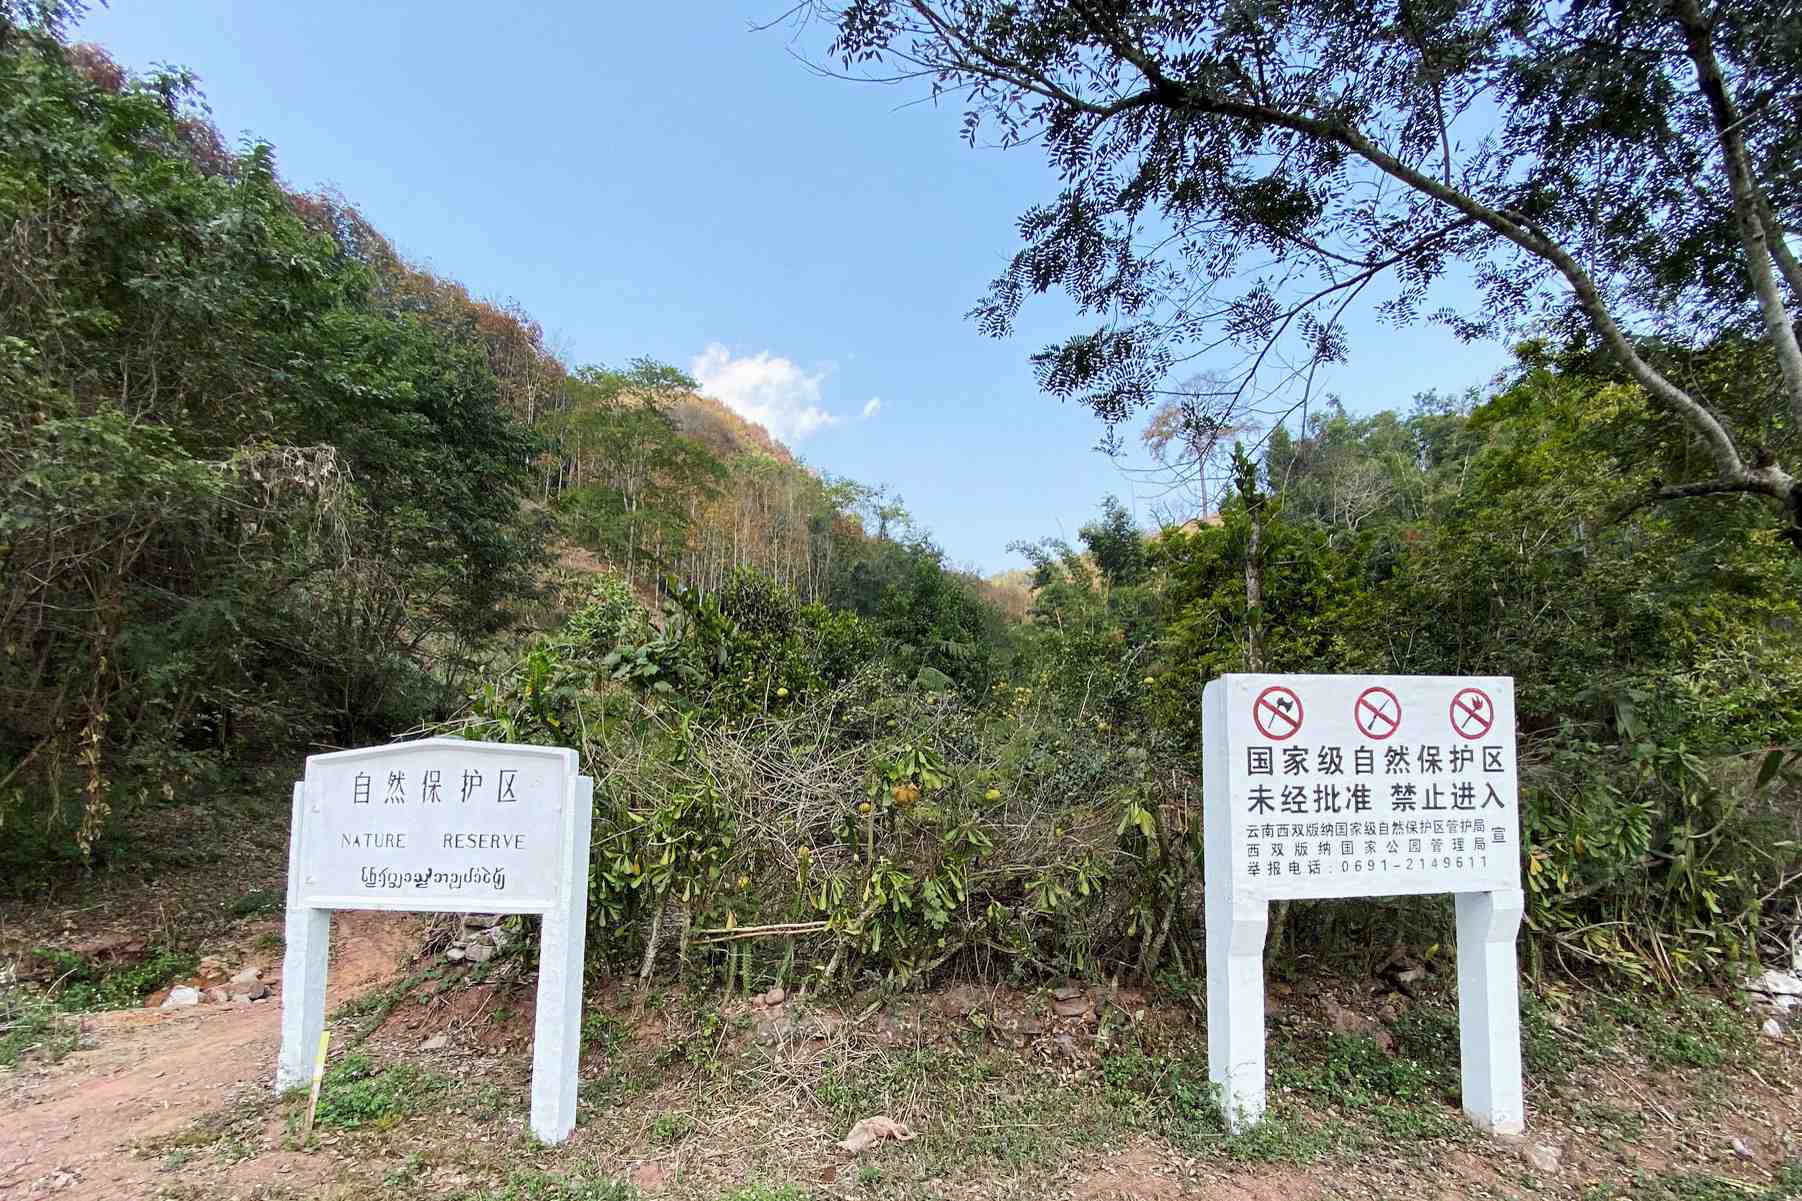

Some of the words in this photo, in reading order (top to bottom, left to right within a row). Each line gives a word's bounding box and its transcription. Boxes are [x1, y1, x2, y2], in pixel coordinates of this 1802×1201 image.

[1247, 745, 1505, 776] 国家级自然保护区
[354, 769, 518, 804] 自然保护区
[1247, 785, 1373, 815] 未经批准
[1391, 783, 1506, 813] 禁止进入
[341, 832, 407, 849] NATURE
[442, 833, 528, 850] RESERVE
[1246, 819, 1486, 838] 云南西双版纳国家级自然保护区管护局
[1247, 838, 1487, 858] 西双版纳国家公园管理局
